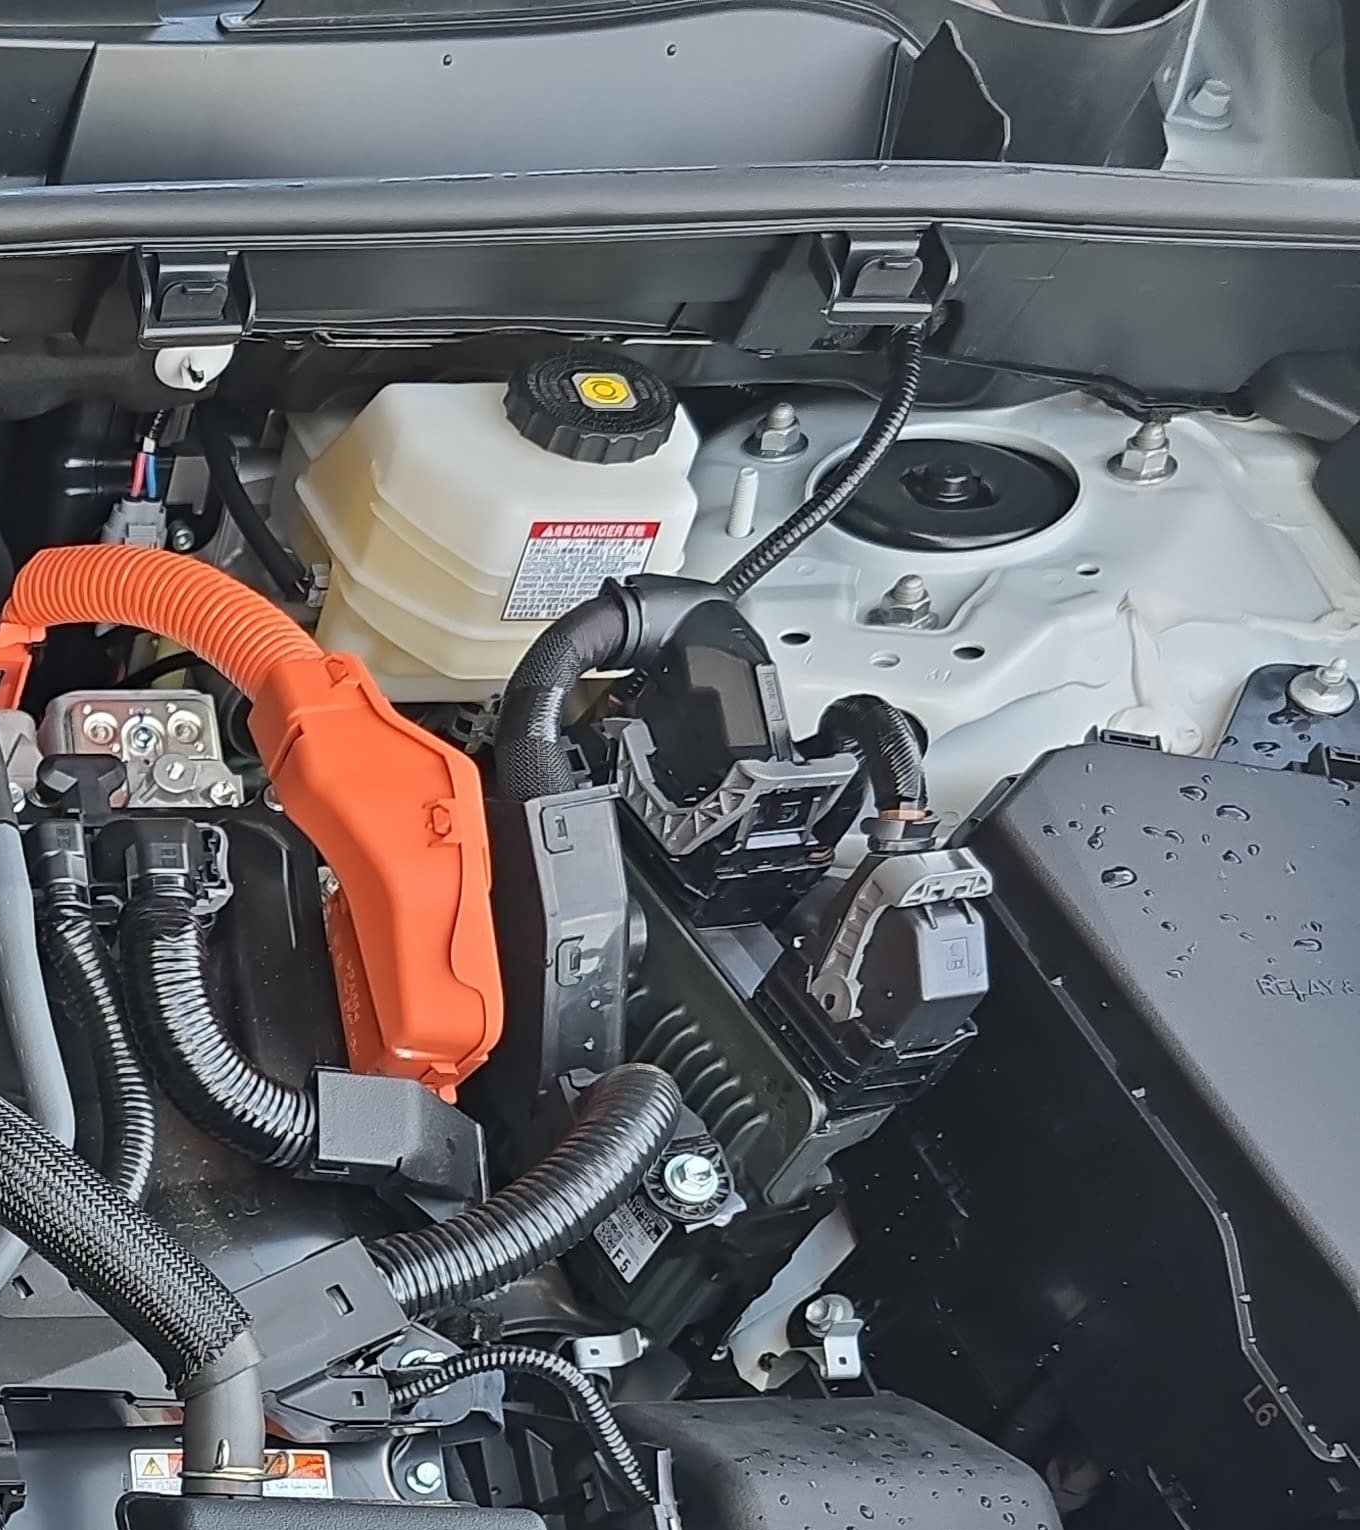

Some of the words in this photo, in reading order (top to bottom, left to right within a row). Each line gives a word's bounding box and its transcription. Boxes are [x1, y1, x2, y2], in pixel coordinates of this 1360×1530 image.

[573, 524, 623, 537] DANGER
[1256, 978, 1333, 1001] RELAY
[1244, 1387, 1279, 1428] L6
